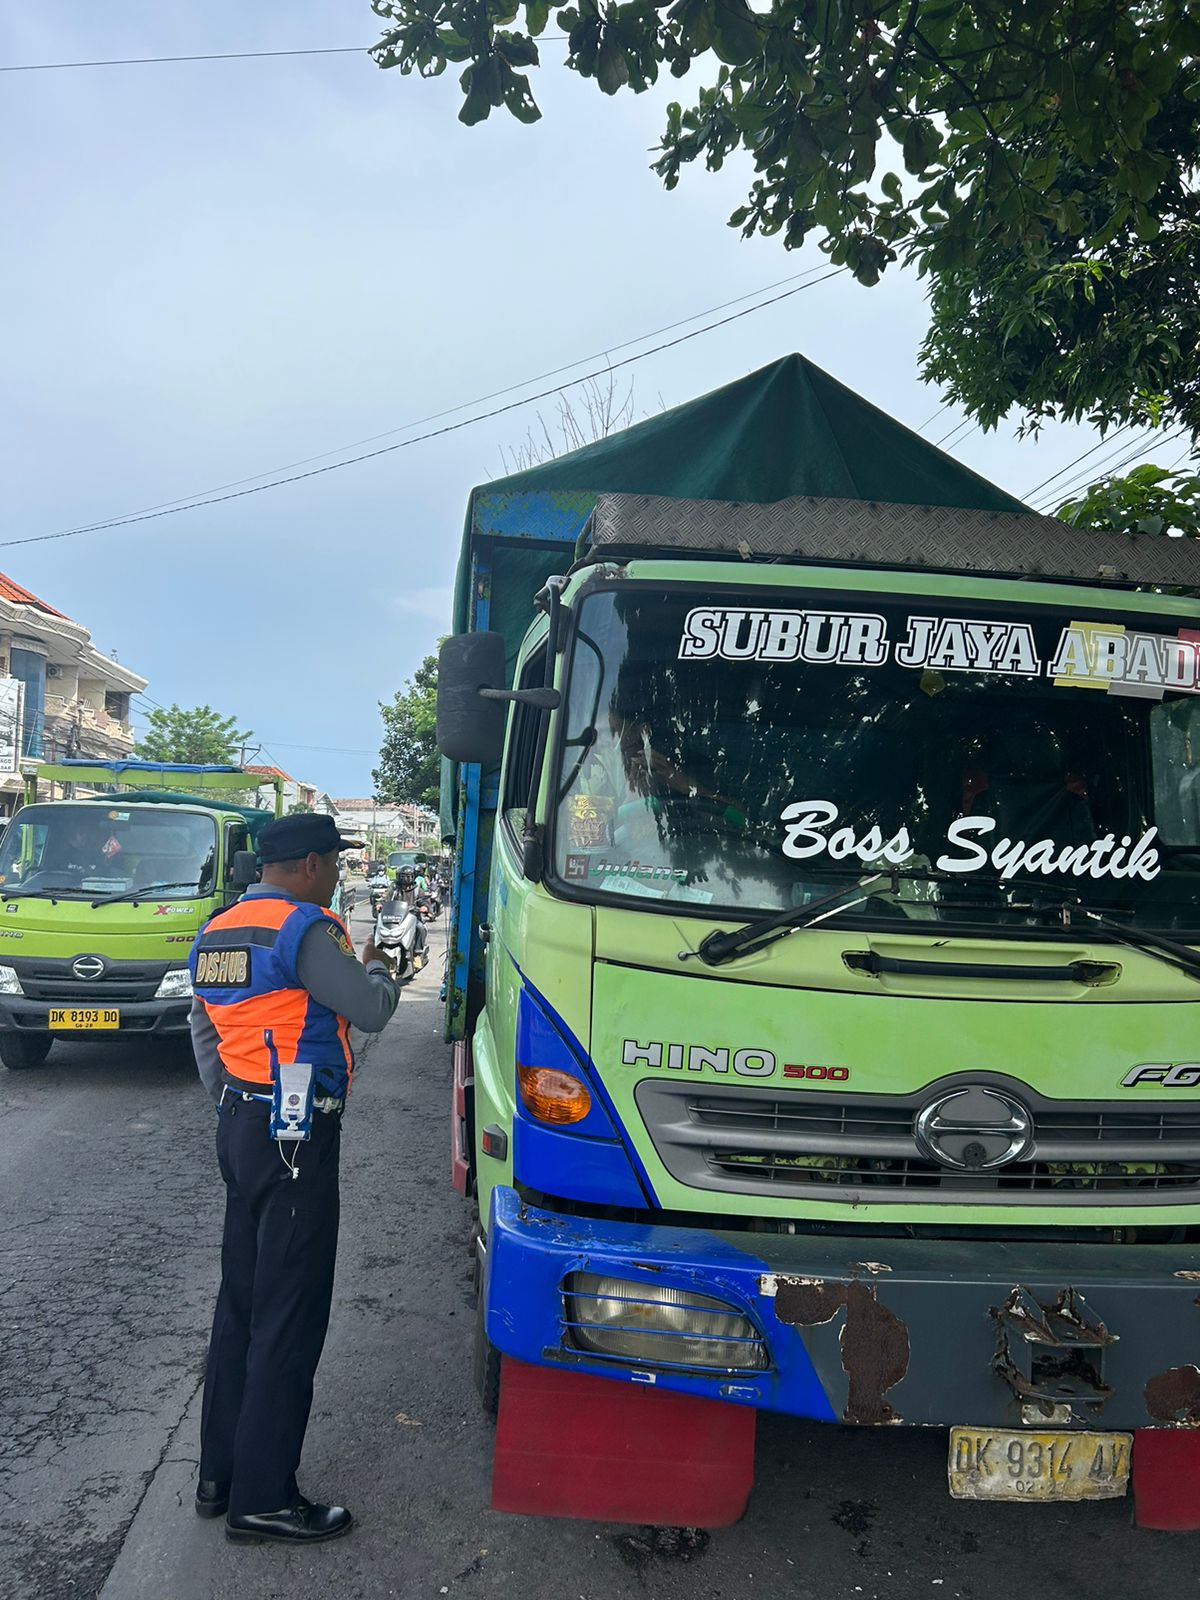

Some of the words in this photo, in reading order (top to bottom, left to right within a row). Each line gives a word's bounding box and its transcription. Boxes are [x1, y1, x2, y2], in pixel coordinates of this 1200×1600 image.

[678, 606, 890, 667] SUBUR
[895, 615, 1041, 677] JAYA
[780, 800, 914, 863] Boss
[936, 816, 1161, 881] Syantik
[195, 950, 248, 984] DISHUB
[51, 1010, 65, 1022] DK
[71, 1010, 98, 1022] 8193
[622, 1039, 776, 1077] HINO
[783, 1064, 849, 1081] 500
[957, 1436, 993, 1476] DK
[1007, 1440, 1073, 1479] 9314
